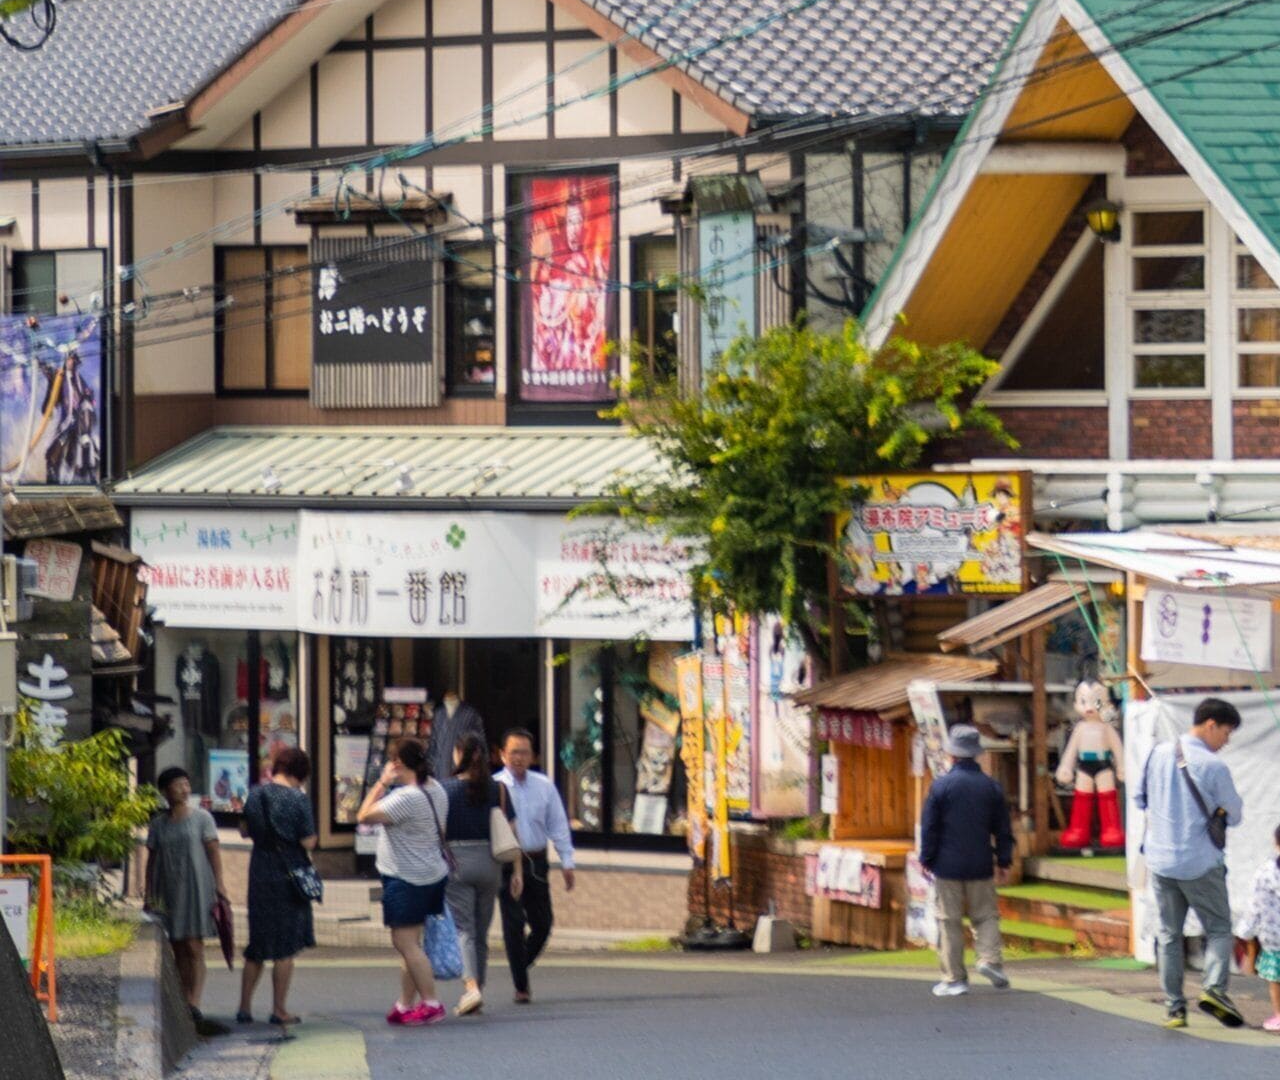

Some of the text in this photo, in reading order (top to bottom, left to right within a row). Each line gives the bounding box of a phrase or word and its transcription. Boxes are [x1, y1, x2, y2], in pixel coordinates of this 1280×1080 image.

[319, 305, 427, 335] お二階へどうぞ
